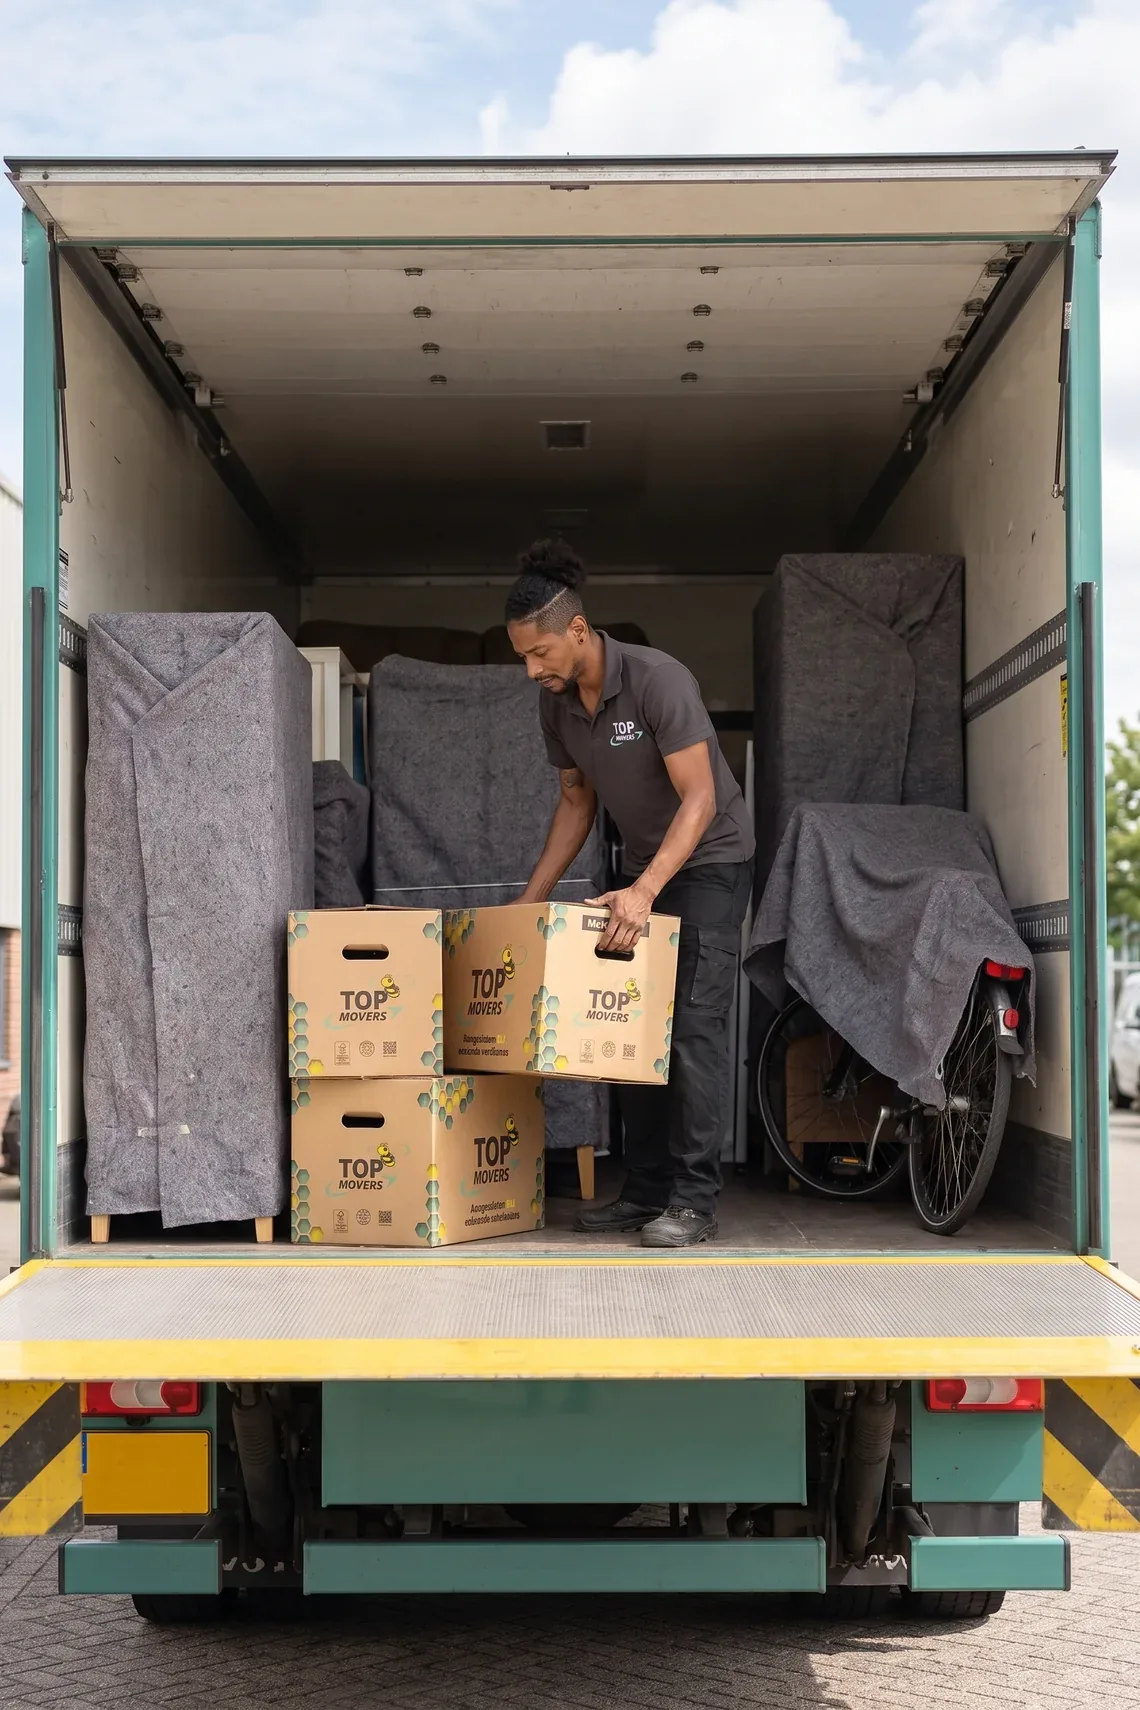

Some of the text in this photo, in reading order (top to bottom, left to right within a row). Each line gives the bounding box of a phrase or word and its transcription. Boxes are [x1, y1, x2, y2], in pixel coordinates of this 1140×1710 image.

[612, 721, 635, 734] TOP
[471, 968, 506, 999] TOP
[340, 990, 388, 1010] TOP
[588, 988, 631, 1011] TOP
[339, 1012, 387, 1022] MOVERS
[467, 1001, 503, 1016] MOVERS
[586, 1010, 630, 1023] MOVERS
[473, 1135, 511, 1168] TOP
[338, 1158, 384, 1179] TOP
[473, 1168, 510, 1185] MOVERS
[338, 1180, 383, 1190] MOVERS
